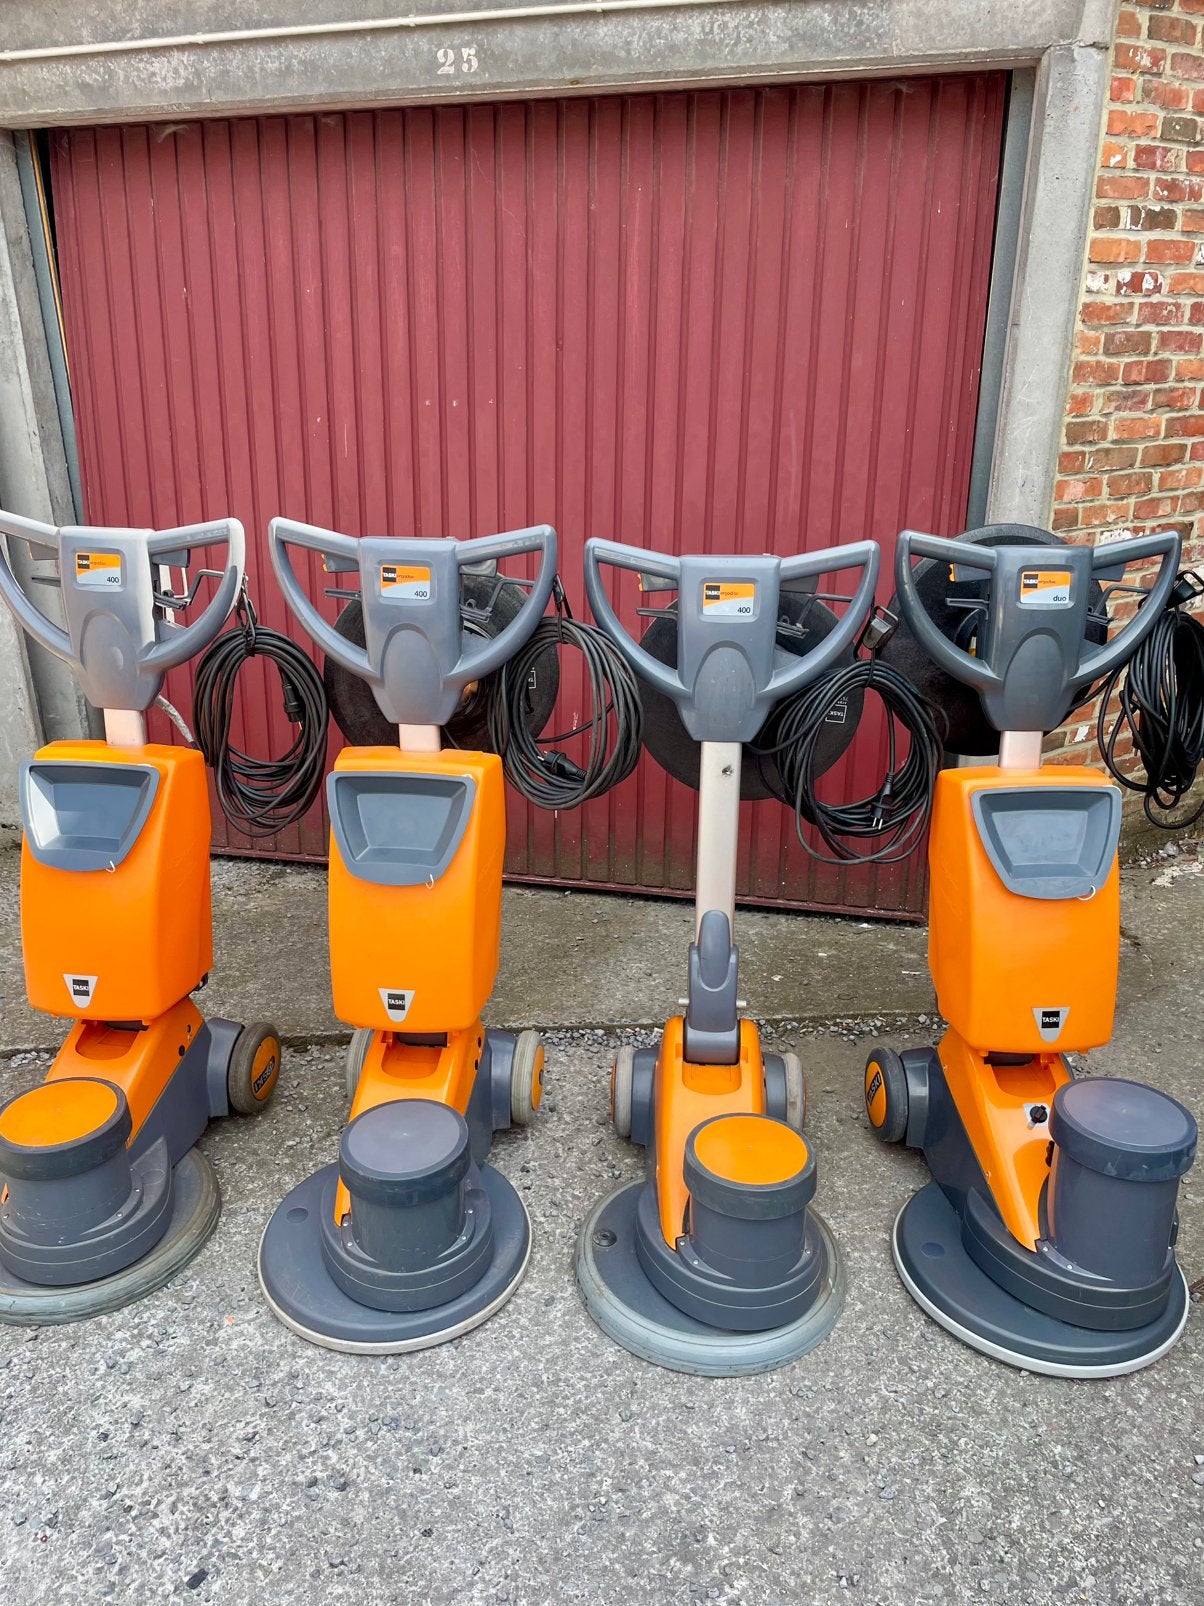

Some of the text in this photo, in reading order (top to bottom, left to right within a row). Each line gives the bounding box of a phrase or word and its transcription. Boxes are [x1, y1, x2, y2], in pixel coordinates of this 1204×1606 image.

[436, 47, 479, 75] 25
[106, 576, 120, 584] 400
[414, 590, 428, 598] 400
[1052, 594, 1067, 602] duo
[737, 606, 751, 614] 400
[388, 998, 405, 1006] TASKI
